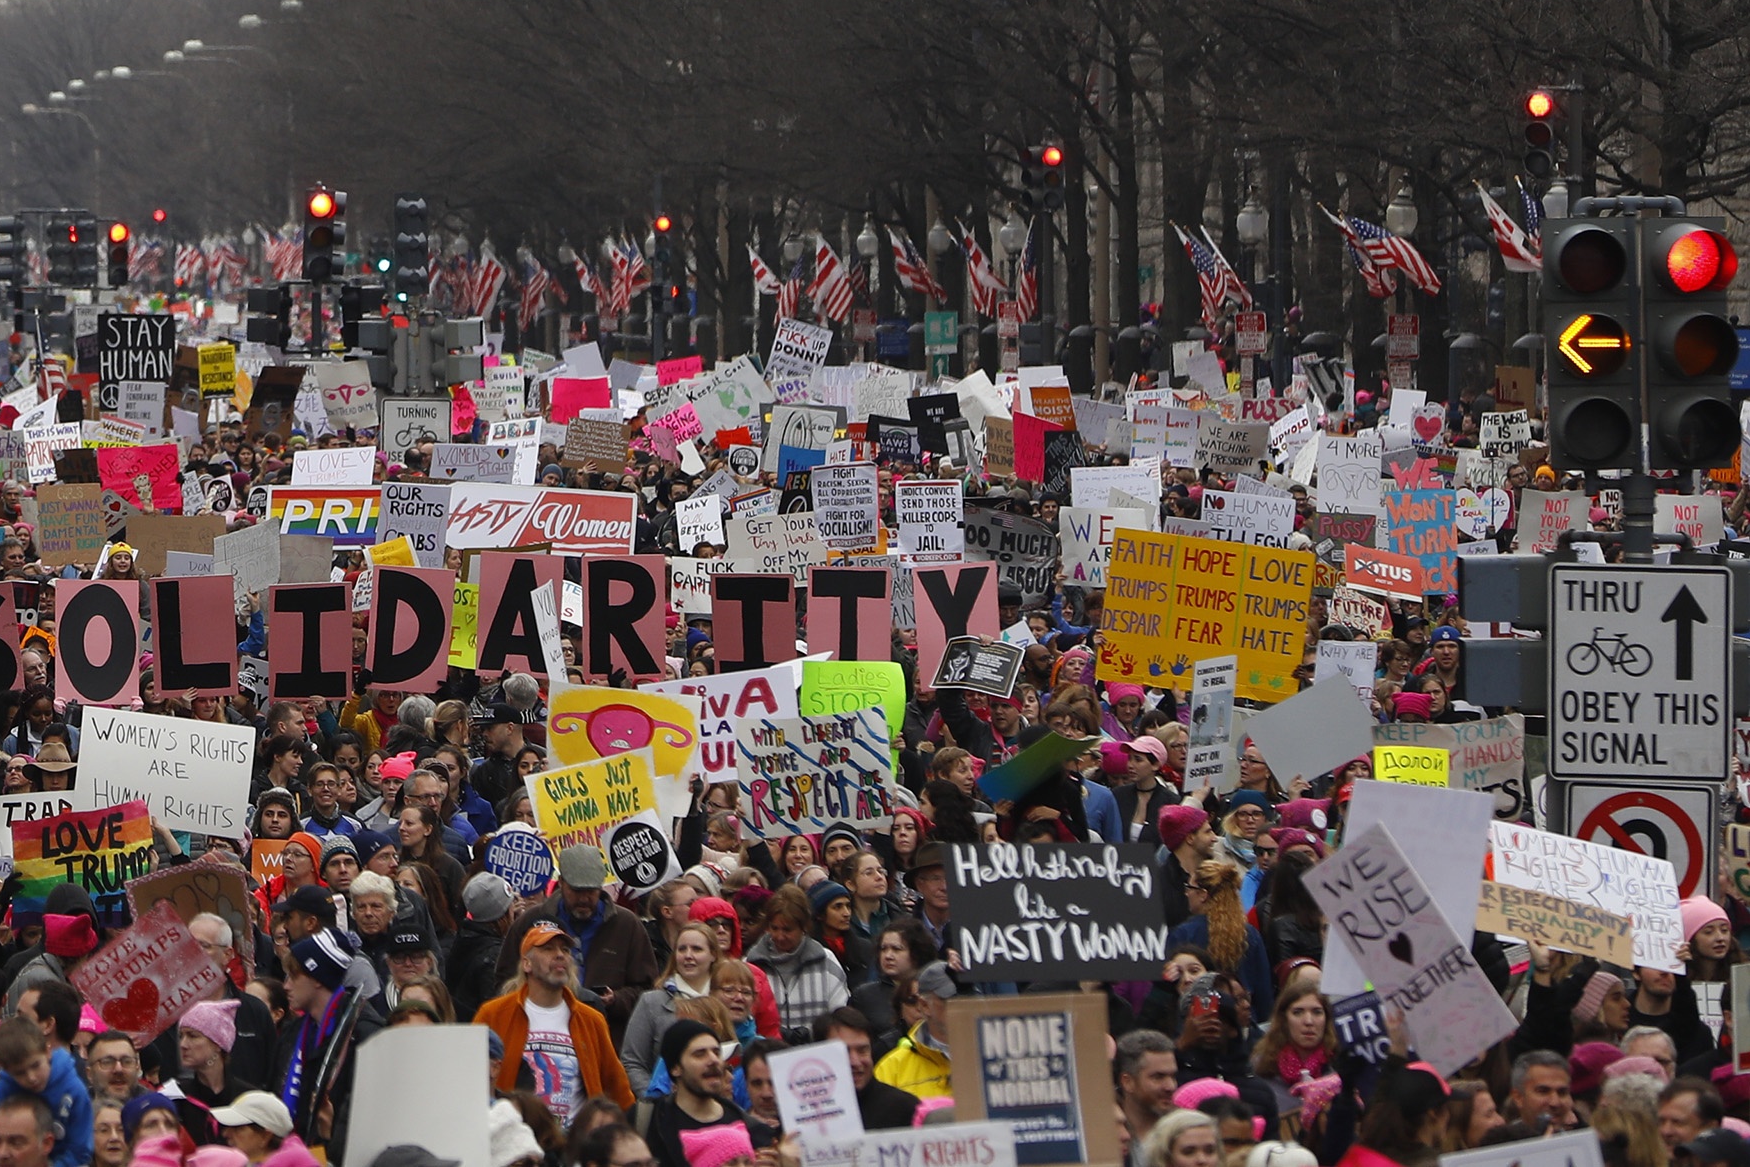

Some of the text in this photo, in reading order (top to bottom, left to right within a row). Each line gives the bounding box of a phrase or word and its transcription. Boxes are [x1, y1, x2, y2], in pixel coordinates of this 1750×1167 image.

[105, 317, 169, 348] STAY
[778, 328, 826, 351] FUCK UP
[100, 348, 173, 381] HUMAN
[773, 341, 825, 365] DONNY
[126, 402, 136, 410] NOT
[397, 407, 438, 420] TURNING
[1200, 438, 1251, 454] WATCHING
[1208, 427, 1249, 442] WE ARE
[307, 452, 357, 473] LOVE
[832, 468, 856, 478] FIGHT
[1389, 457, 1443, 490] WE
[387, 485, 424, 501] OUR
[902, 498, 956, 508] SEND THOSE
[1544, 498, 1570, 514] NOT
[280, 498, 378, 534] PRI
[531, 502, 631, 540] Women
[746, 515, 815, 534] GET YOUR
[902, 511, 957, 523] KILLER COPS
[1385, 493, 1454, 526] WON'T
[1540, 514, 1571, 529] YOUR
[1674, 505, 1699, 521] NOT
[818, 521, 873, 537] SOCIALISM!
[916, 536, 945, 551] JAIL!
[925, 524, 934, 533] TO
[1388, 524, 1458, 556] TURN
[1114, 538, 1309, 586] FAITH HOPE LOVE
[1110, 576, 1307, 623] TRUMPS TRUMPS TRUMPS
[1563, 580, 1641, 613] THRU
[1320, 646, 1374, 660] WHY ARE
[818, 666, 891, 688] Ladies
[1561, 690, 1719, 726] OBEY THIS
[91, 717, 249, 764] WOMEN'S RIGHTS
[1193, 750, 1220, 763] ACT ON
[1561, 731, 1668, 765] SIGNAL
[148, 760, 189, 780] ARE
[544, 758, 631, 804] GIRLS JUST
[94, 778, 235, 830] HUMAN RIGHTS
[554, 787, 640, 827] WANNA HAVE
[750, 770, 883, 829] RESPECT FOR
[856, 788, 894, 820] ALL
[41, 811, 125, 860] LOVE
[501, 833, 543, 854] KEEP
[612, 828, 653, 859] RESPECT
[489, 845, 551, 878] ABORTION
[616, 840, 663, 872] WOMEN OF COLOR
[952, 843, 1023, 887] Hell
[1022, 844, 1078, 880] hath
[492, 867, 541, 892] LEGAL
[1320, 847, 1386, 900] WE
[1505, 851, 1679, 910] RIGHTS RIGHTS
[1014, 882, 1090, 919] like a
[1335, 866, 1430, 957] RISE
[81, 934, 141, 988] LOVE
[960, 920, 1169, 970] NASTY WOMAN
[99, 925, 183, 998] TRUMPS
[160, 964, 218, 1017] HATE
[1384, 943, 1476, 1013] TOGETHER
[983, 1017, 1065, 1060] NONE
[988, 1080, 1070, 1108] NORMAL
